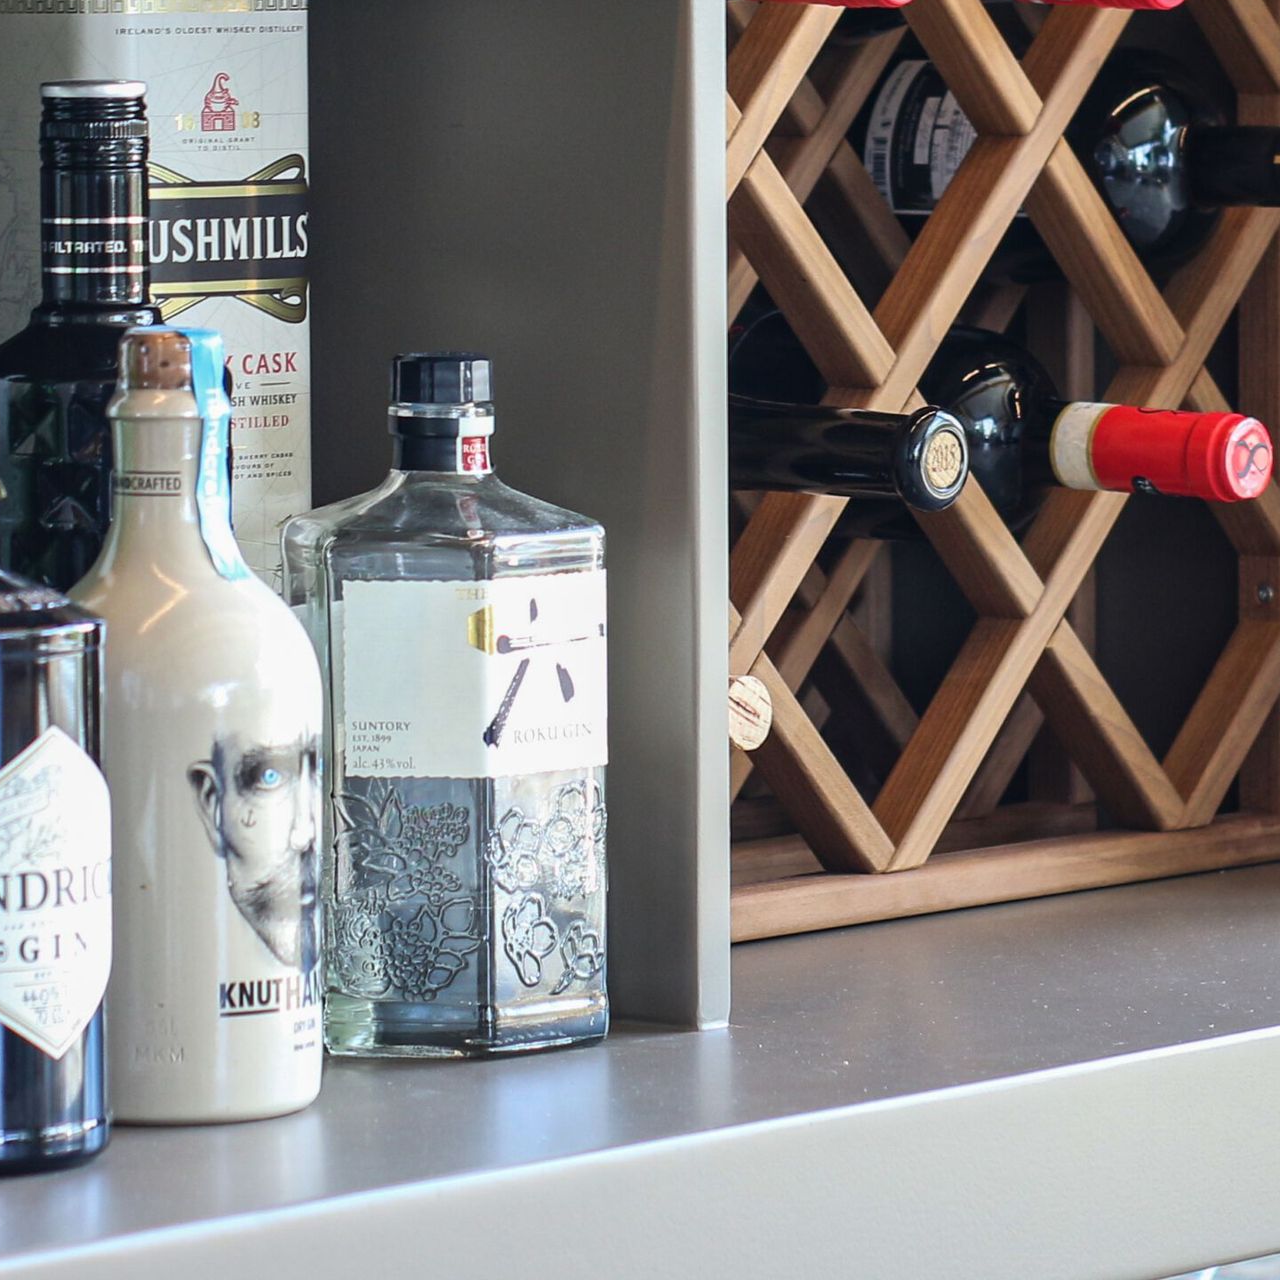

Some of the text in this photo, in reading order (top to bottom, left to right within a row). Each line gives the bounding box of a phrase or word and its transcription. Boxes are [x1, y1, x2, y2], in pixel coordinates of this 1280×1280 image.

[175, 26, 213, 35] OLDEST
[216, 25, 257, 34] WHISKEY
[148, 212, 309, 263] USHMILLS
[242, 352, 298, 375] CASK
[249, 393, 297, 407] WHISKEY
[230, 414, 290, 430] STILLED
[351, 720, 411, 732] SUNTORY
[372, 734, 392, 744] 1899
[513, 723, 594, 744] ROKU GIN
[352, 745, 380, 753] JAPAN
